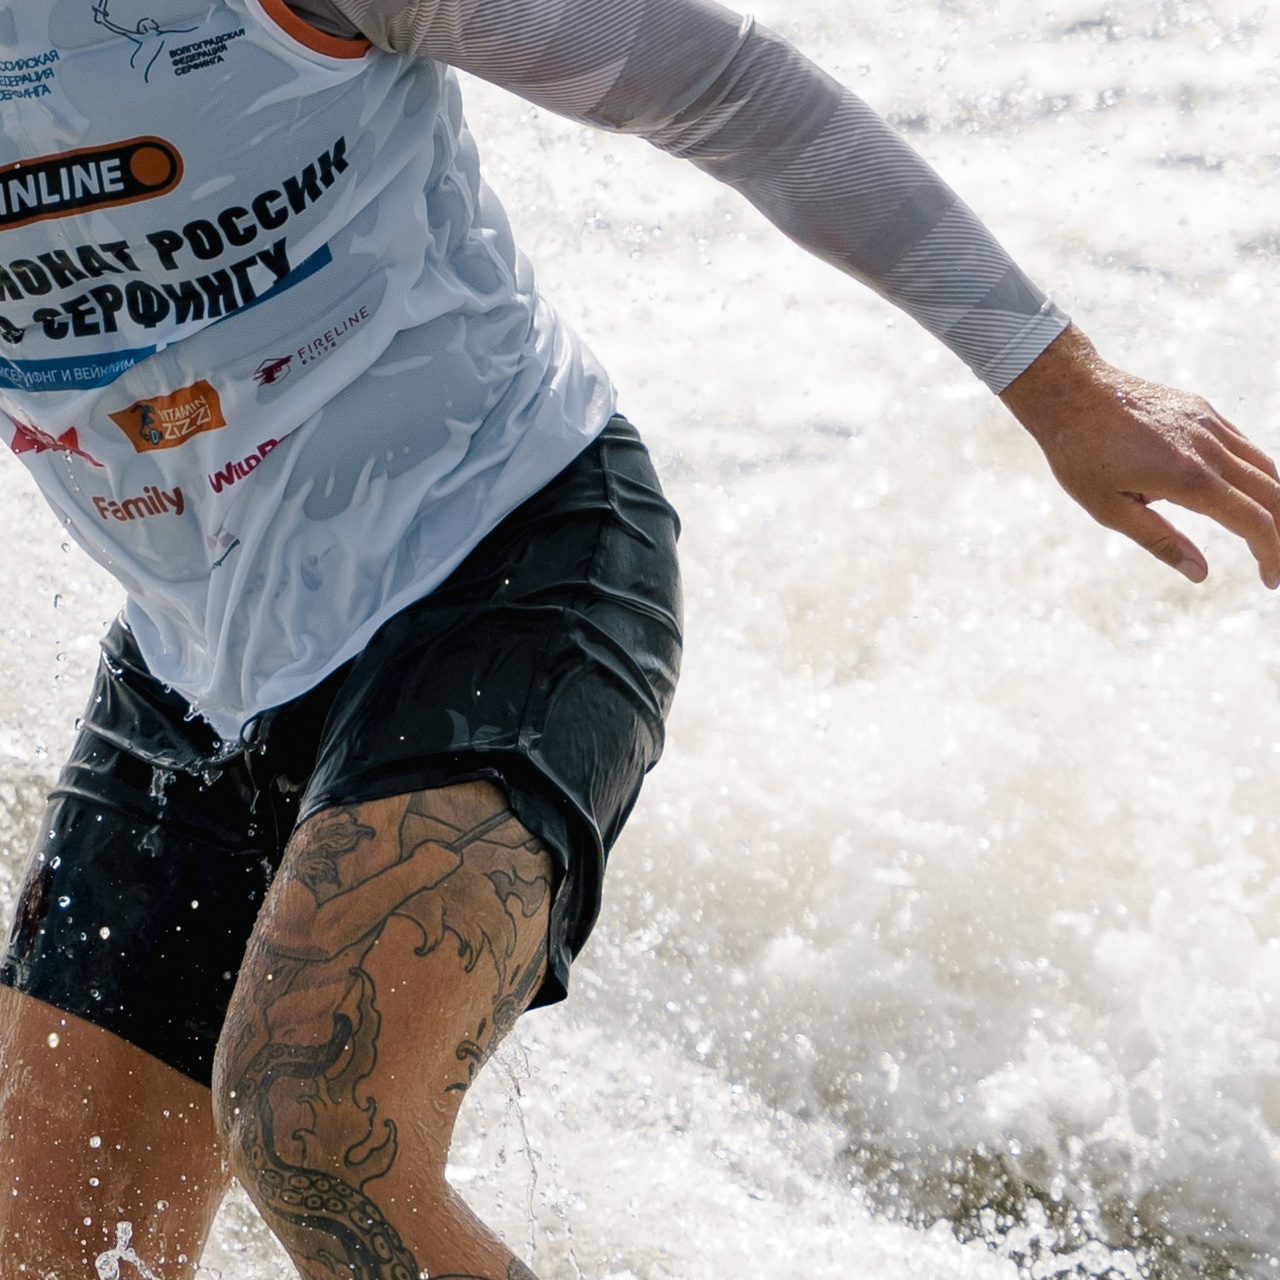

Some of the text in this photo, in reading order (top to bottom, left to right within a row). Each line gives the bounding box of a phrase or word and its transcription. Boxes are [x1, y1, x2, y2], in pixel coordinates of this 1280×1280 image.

[169, 28, 245, 58] ВОЛГОГРАДСКАЯ
[172, 43, 228, 66] ФЕДЕРАЦИЯ
[174, 55, 225, 76] СЕРФИНГА
[32, 237, 293, 341] СЕРФИНГУ
[297, 305, 369, 359] FIRELINE
[61, 369, 72, 381] И
[157, 396, 206, 422] VITAMIN
[92, 486, 184, 521] Family
